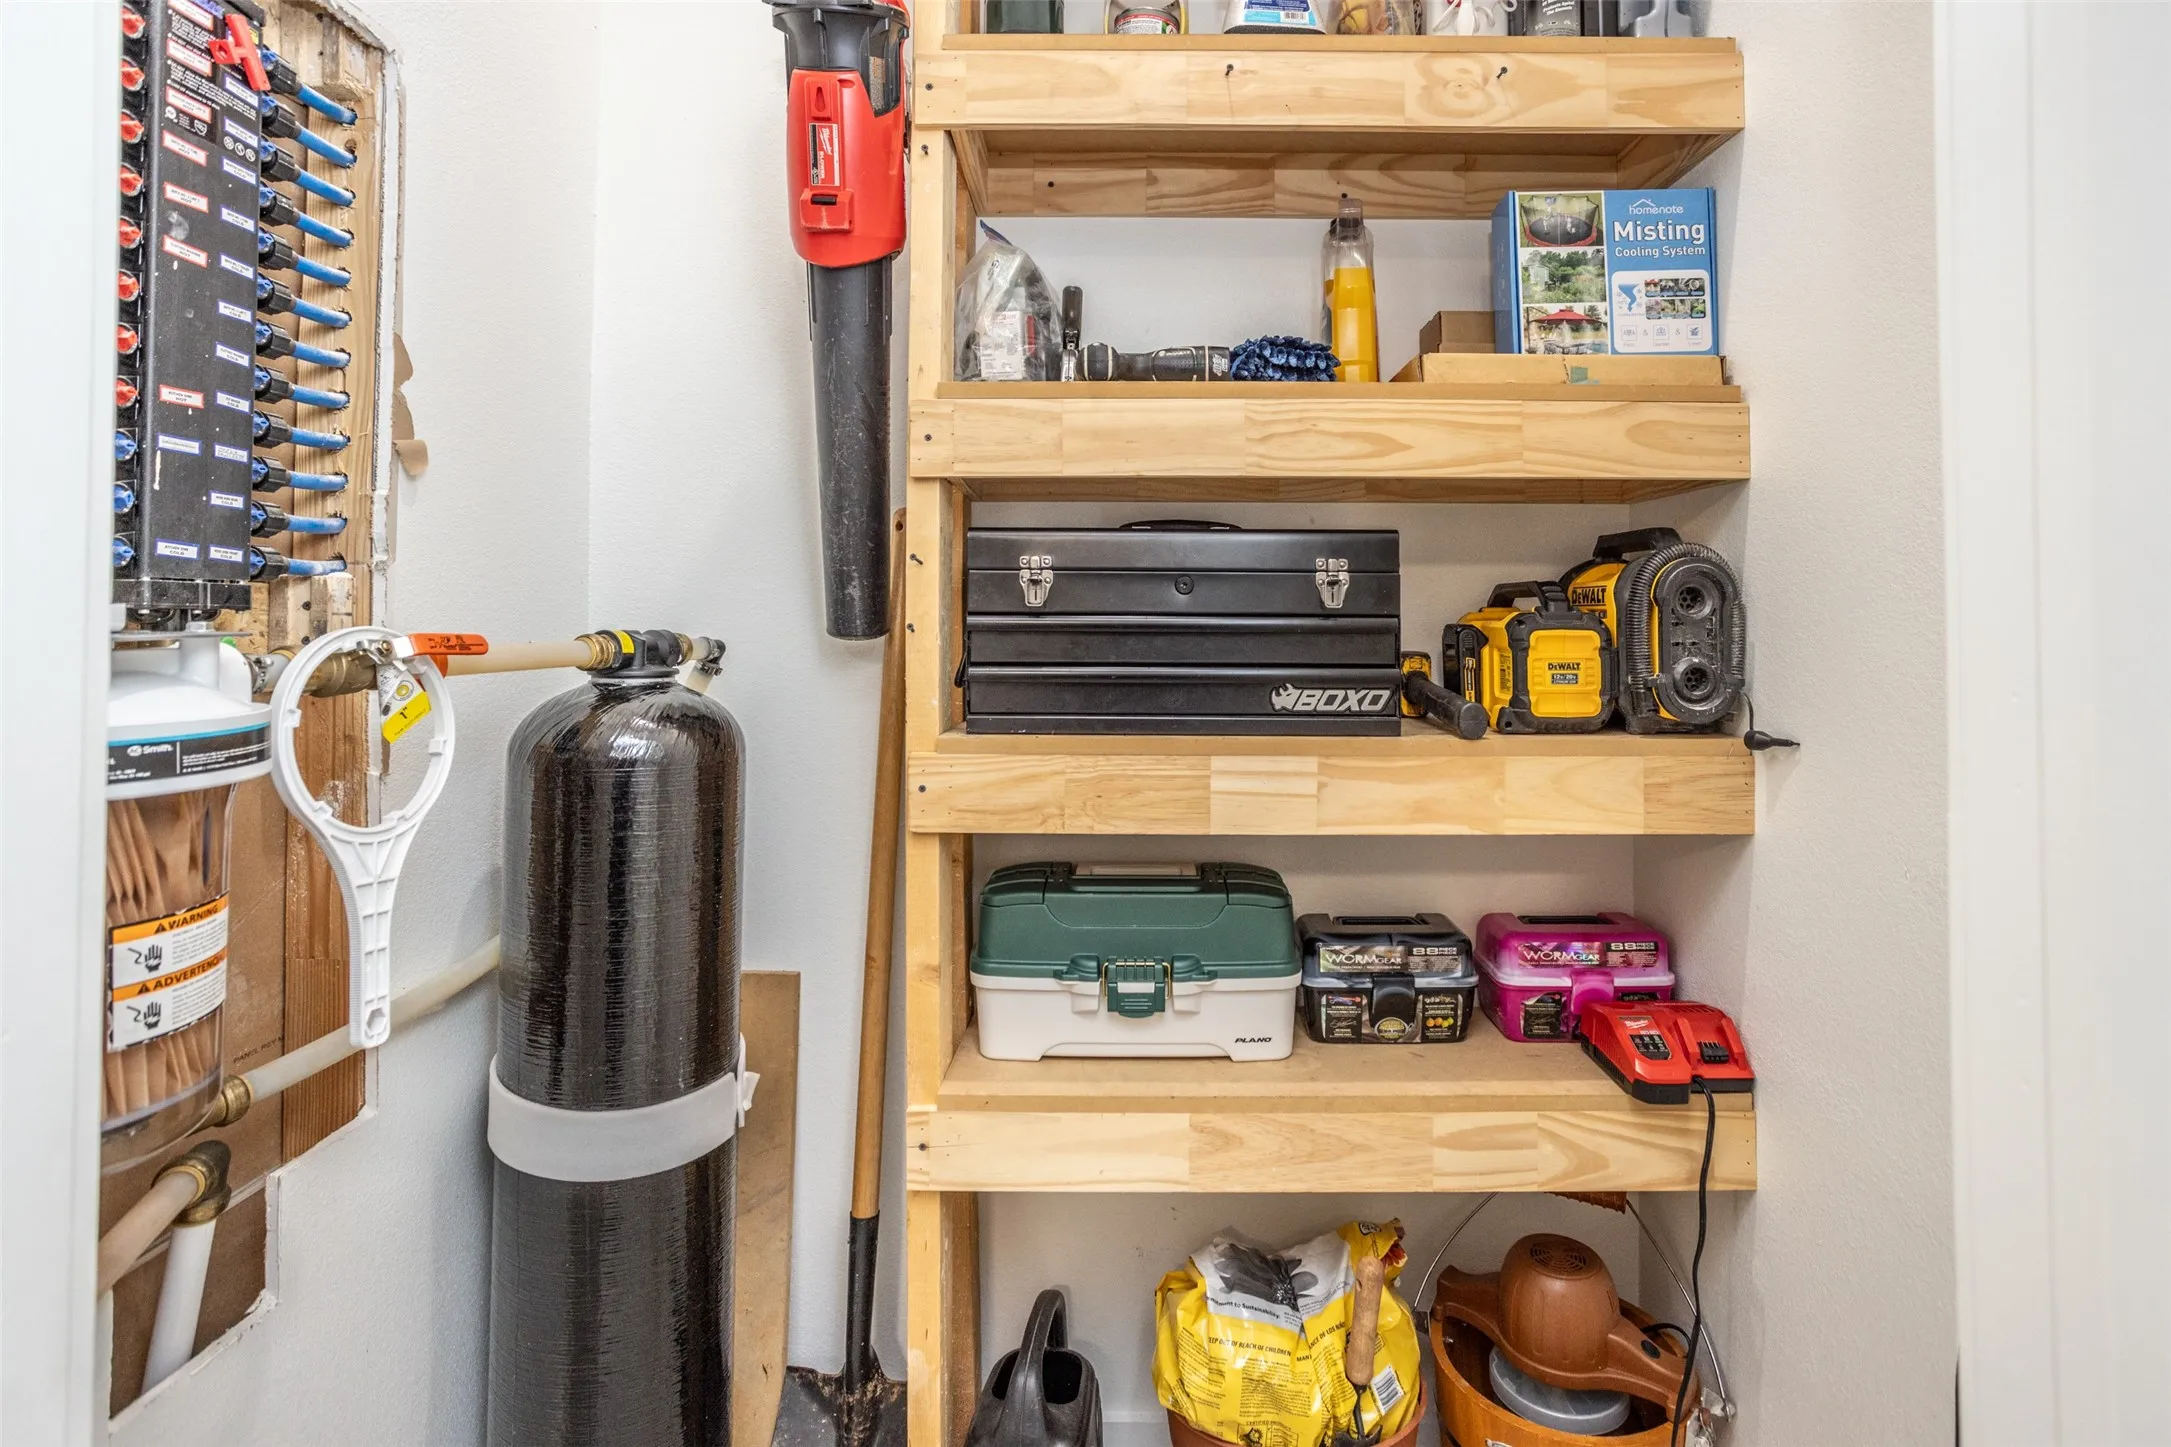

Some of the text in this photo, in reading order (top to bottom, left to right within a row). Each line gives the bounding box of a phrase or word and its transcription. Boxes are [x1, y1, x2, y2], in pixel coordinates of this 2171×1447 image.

[1629, 205, 1684, 214] homenote
[1613, 220, 1705, 245] Misting
[1615, 246, 1706, 258] Cooling System
[1293, 689, 1390, 711] BOXO
[168, 905, 219, 930] WARNING
[1413, 947, 1438, 955] 88
